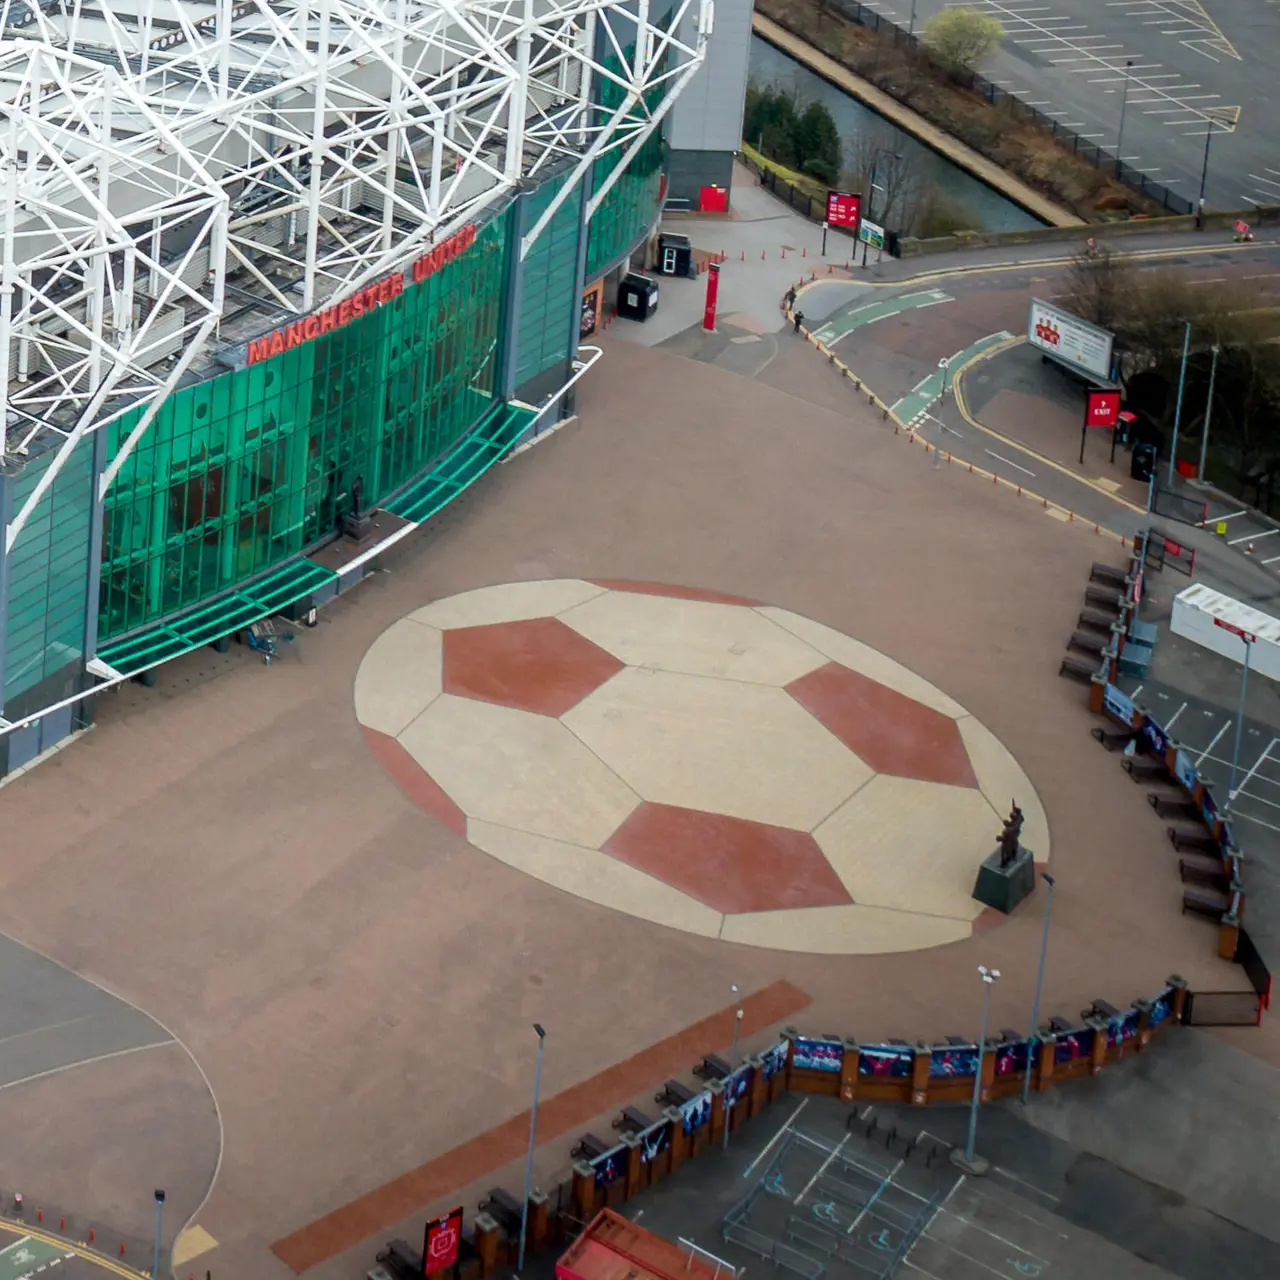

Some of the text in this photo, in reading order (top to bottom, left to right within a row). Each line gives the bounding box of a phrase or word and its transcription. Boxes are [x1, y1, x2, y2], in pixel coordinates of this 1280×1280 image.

[247, 223, 477, 366] MANCHESTER UNITED
[1094, 408, 1111, 416] EXIT
